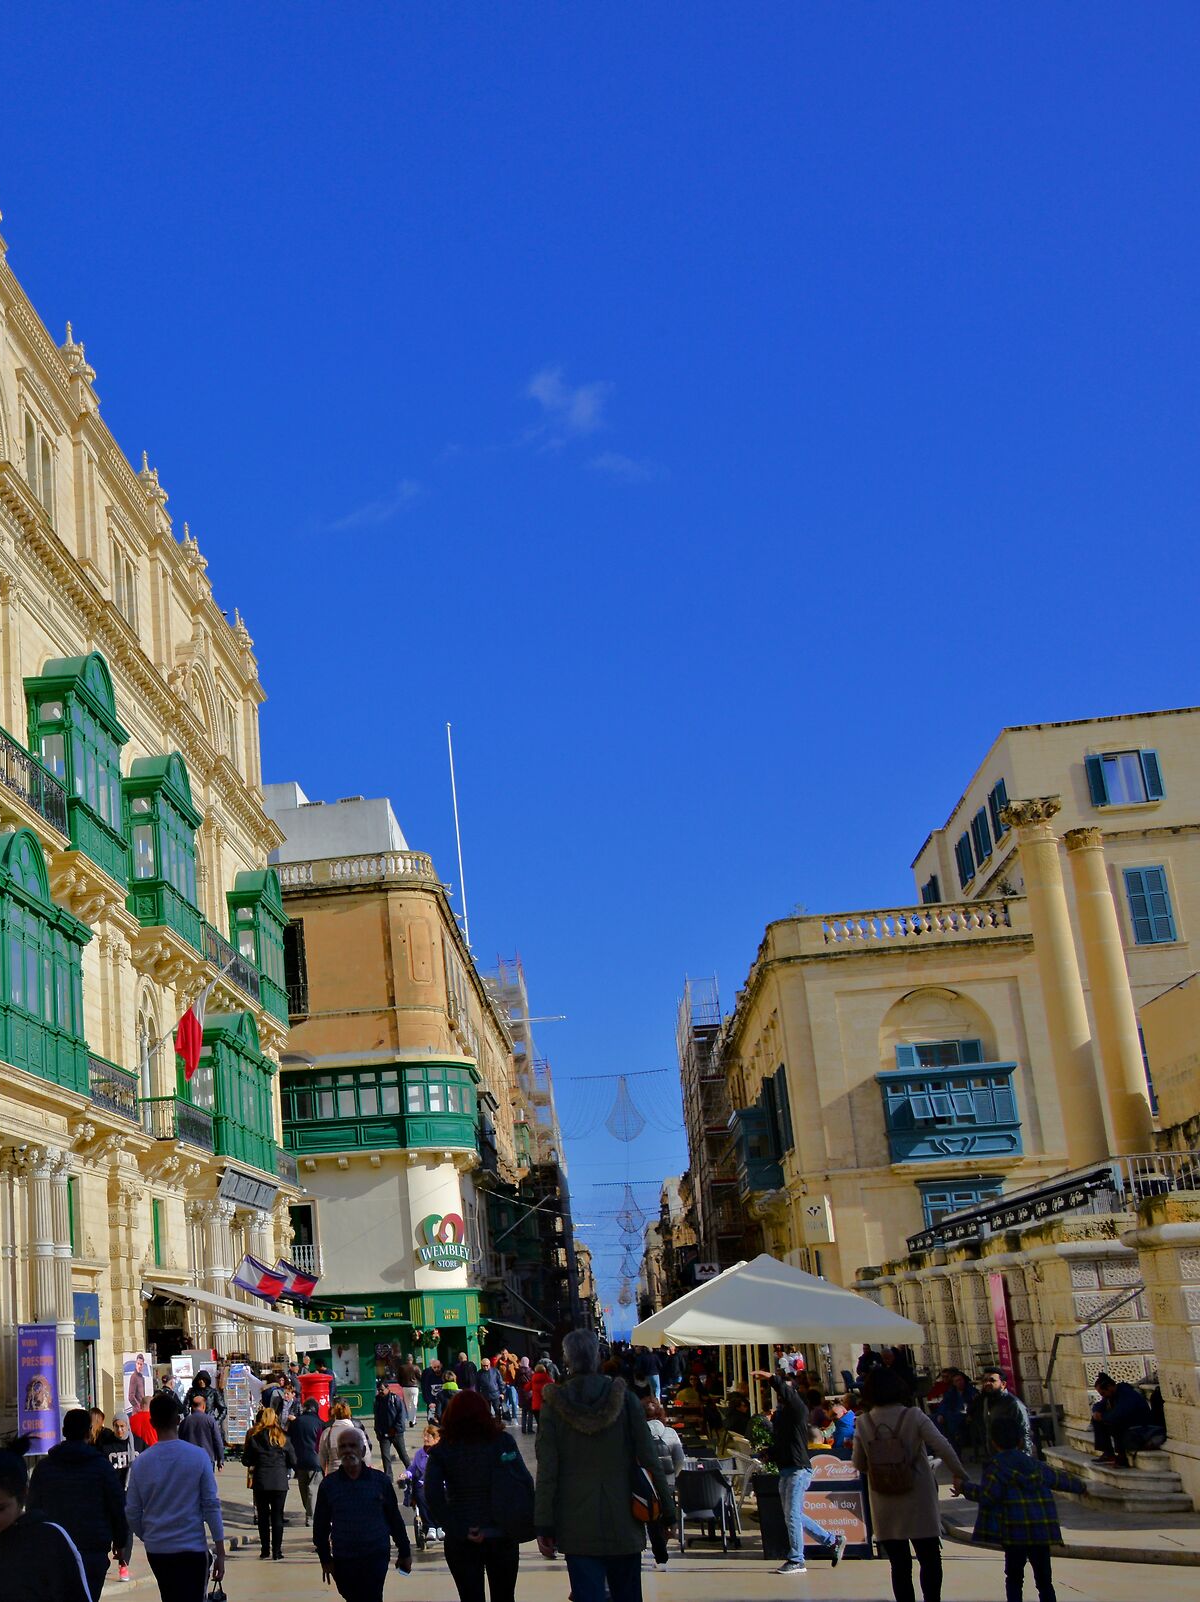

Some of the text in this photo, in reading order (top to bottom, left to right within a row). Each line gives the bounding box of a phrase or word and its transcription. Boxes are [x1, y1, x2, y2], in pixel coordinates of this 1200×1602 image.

[421, 1245, 470, 1261] WEMBLEY
[437, 1260, 458, 1268] STORE
[803, 1500, 857, 1510] Open all day
[829, 1517, 858, 1526] seating
